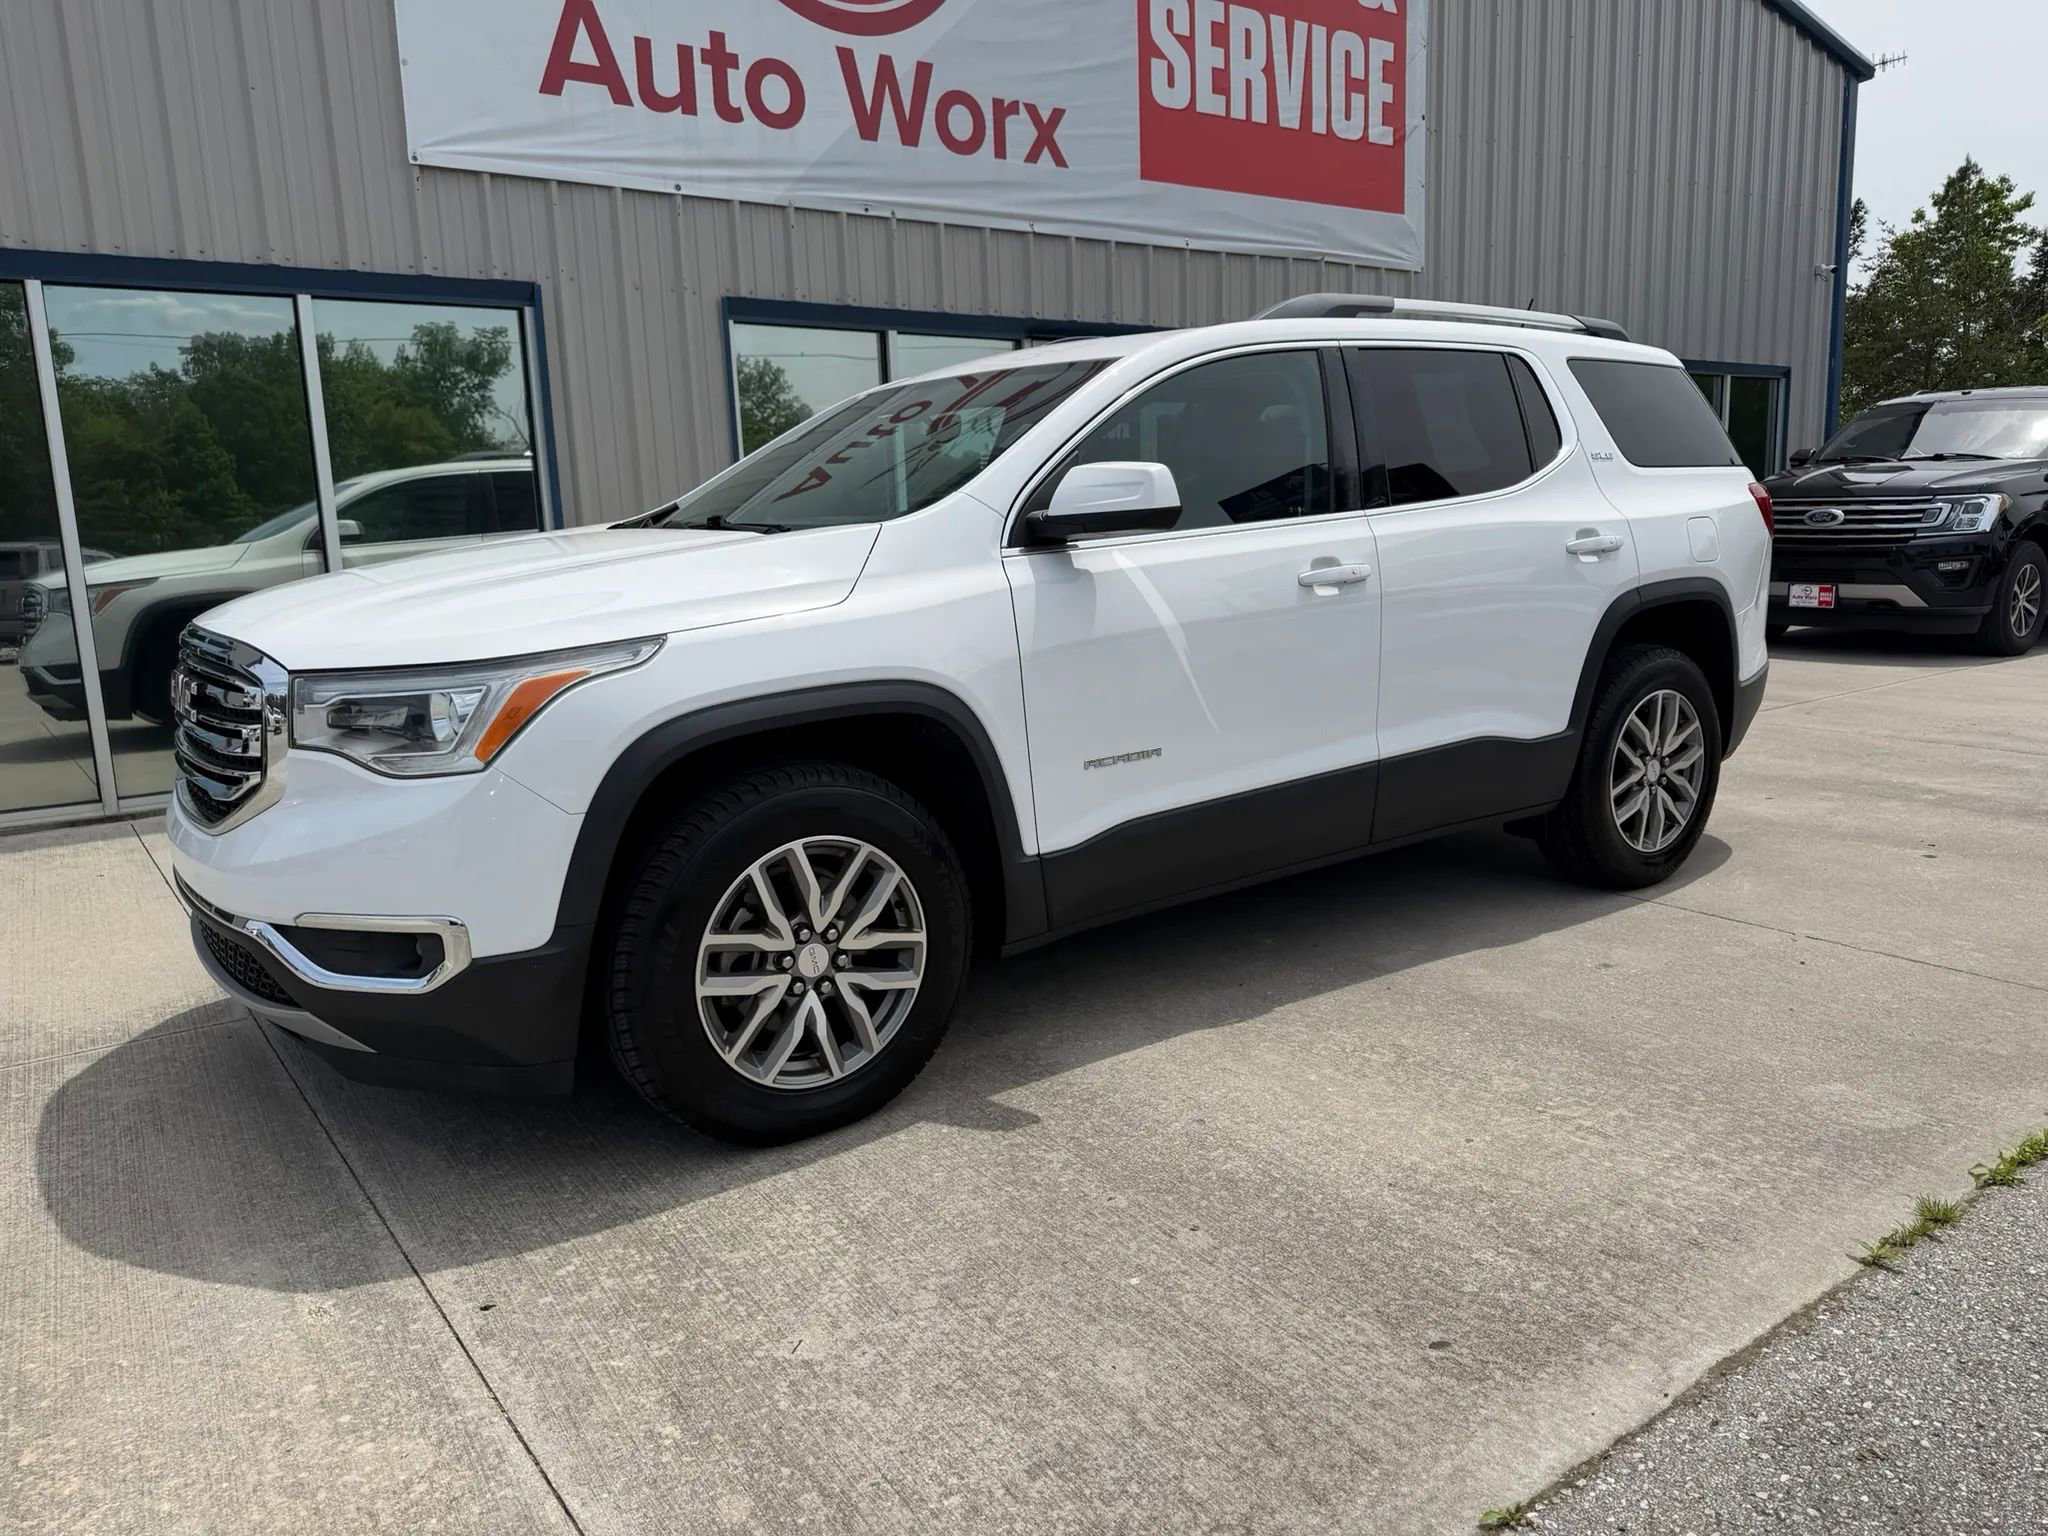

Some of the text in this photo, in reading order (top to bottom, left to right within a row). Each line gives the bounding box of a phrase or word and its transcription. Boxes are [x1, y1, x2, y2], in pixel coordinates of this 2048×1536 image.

[538, 0, 1070, 169] Auto Worx
[1150, 0, 1395, 146] SERVICE
[1084, 747, 1163, 771] ACADIA
[808, 946, 820, 975] GMC
